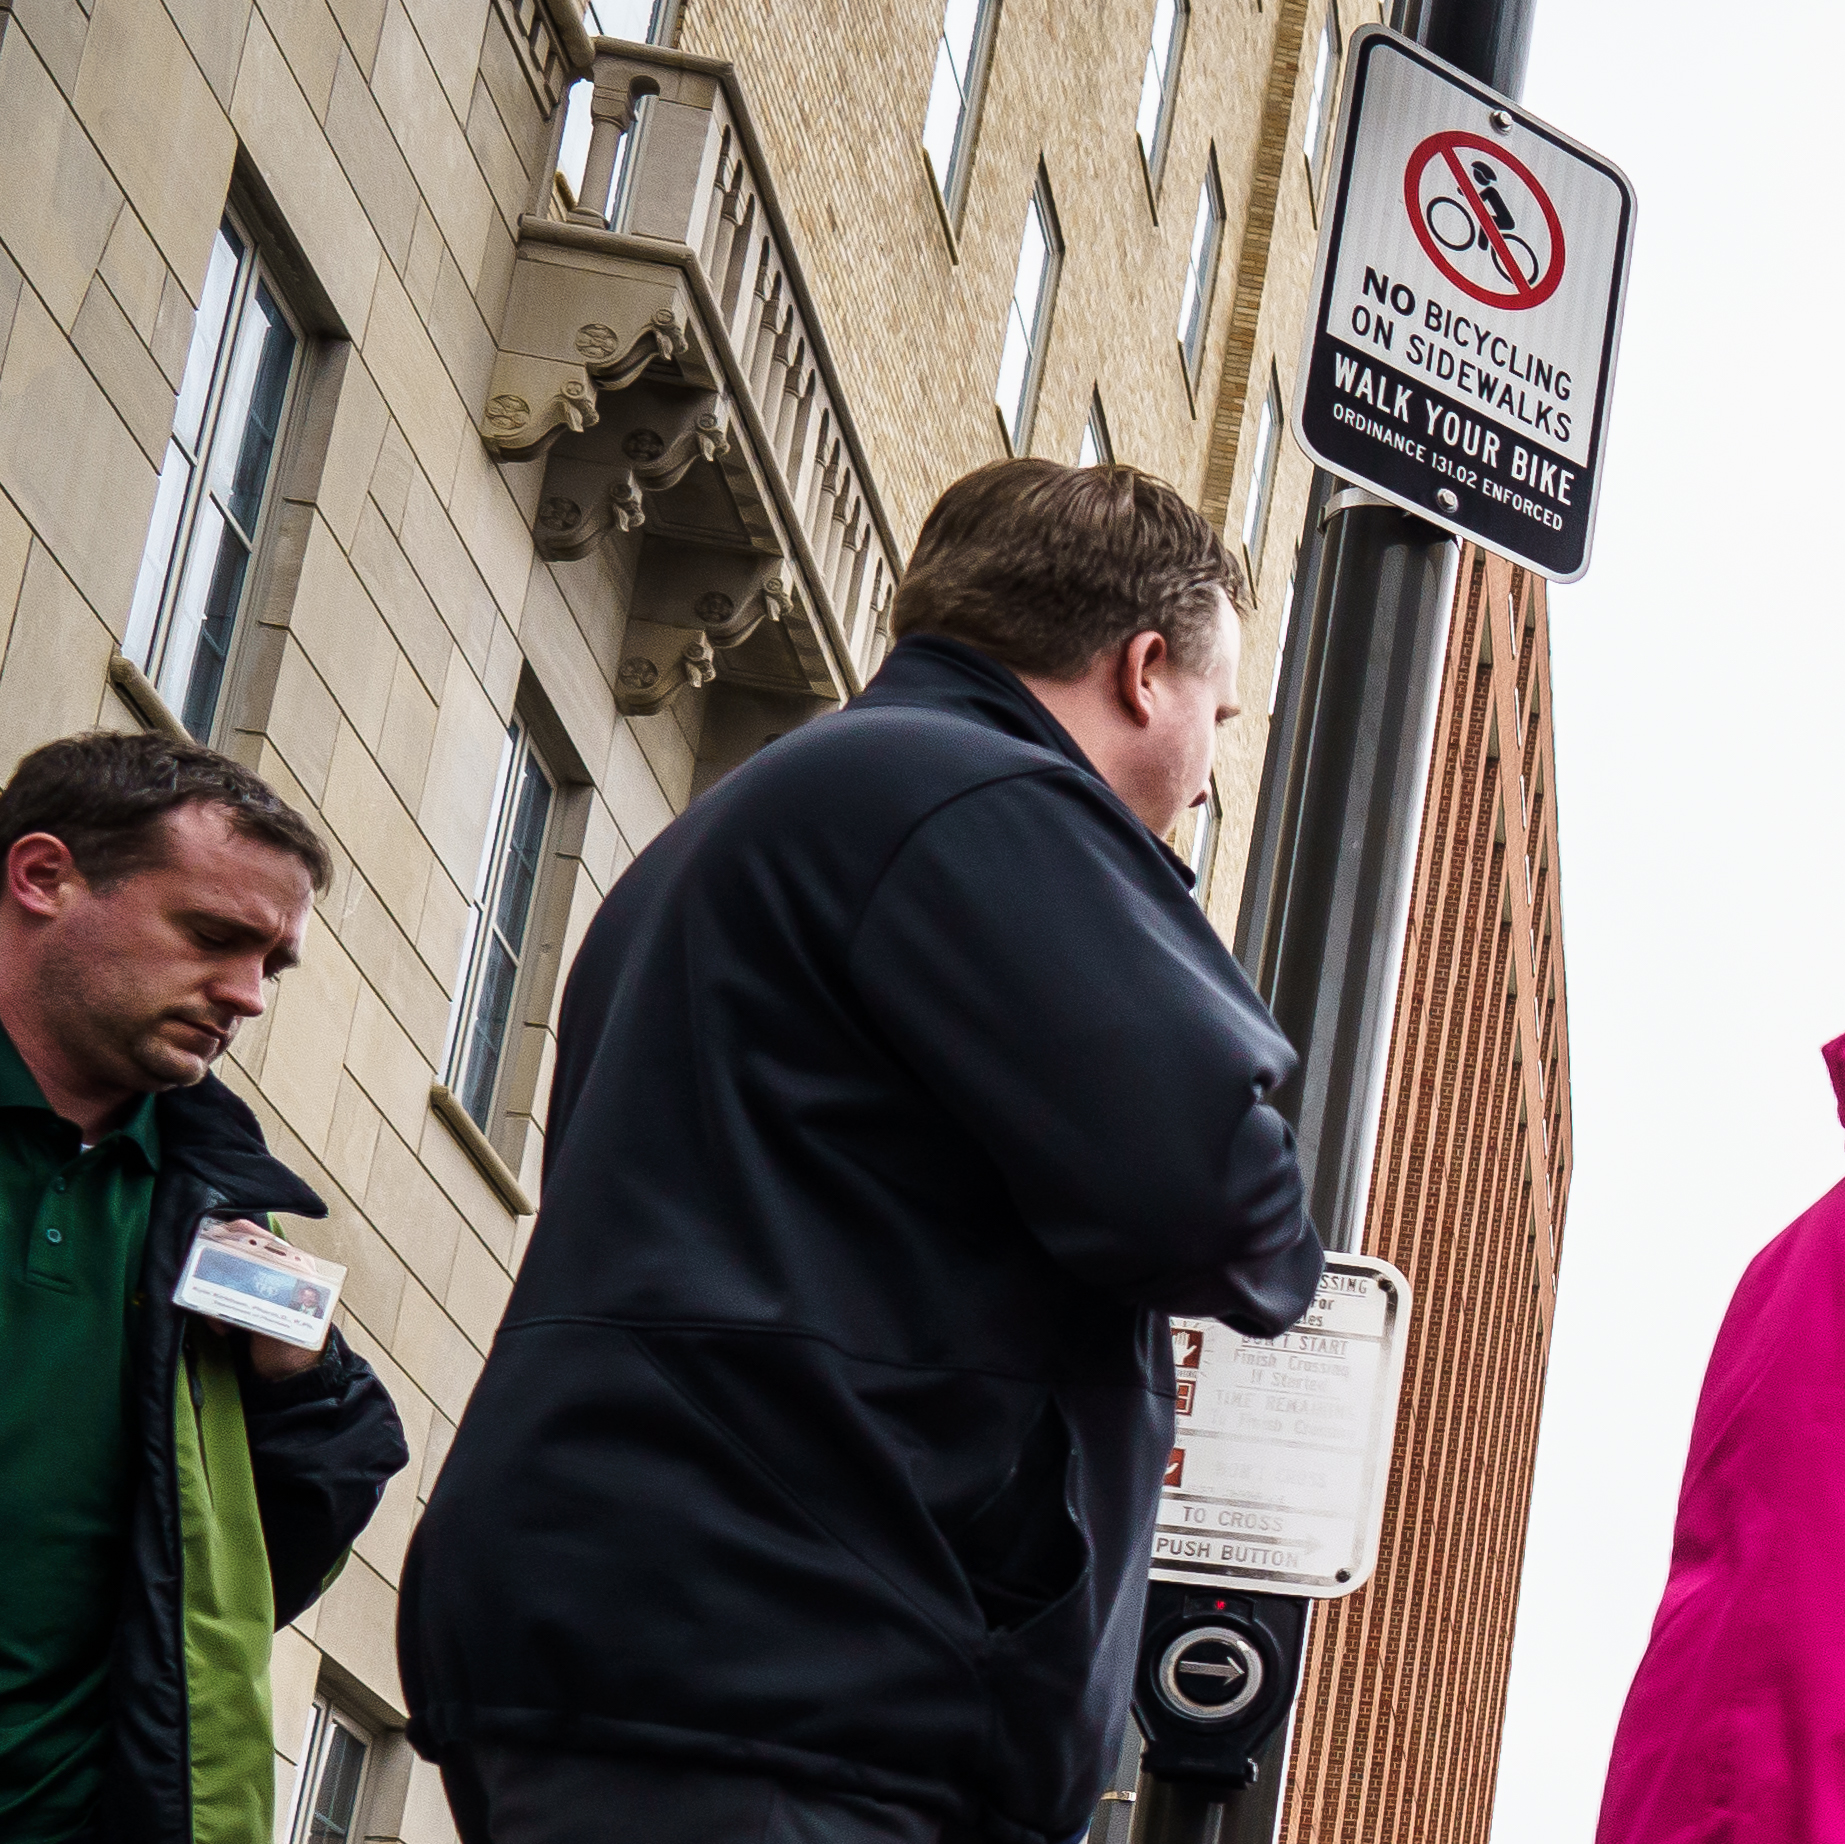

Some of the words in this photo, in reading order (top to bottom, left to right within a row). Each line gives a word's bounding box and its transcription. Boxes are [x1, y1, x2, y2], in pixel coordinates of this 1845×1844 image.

[1364, 266, 1415, 316] NO
[1425, 299, 1572, 400] BICYCLING
[1352, 306, 1392, 351] ON
[1406, 336, 1572, 443] SIDEWALKS
[1333, 405, 1424, 462] ORDINANCE
[1432, 452, 1477, 489] 131.02
[1483, 480, 1562, 531] ENFORCED
[1334, 352, 1411, 423] WALK
[1425, 399, 1499, 469] YOUR
[1511, 446, 1575, 506] BIKE
[1319, 1274, 1368, 1294] SSING
[1299, 1336, 1348, 1355] START
[1155, 1537, 1212, 1558] PUSH
[1220, 1545, 1299, 1567] BUTTON
[1183, 1505, 1206, 1524] TO
[1218, 1510, 1285, 1532] CROSS
